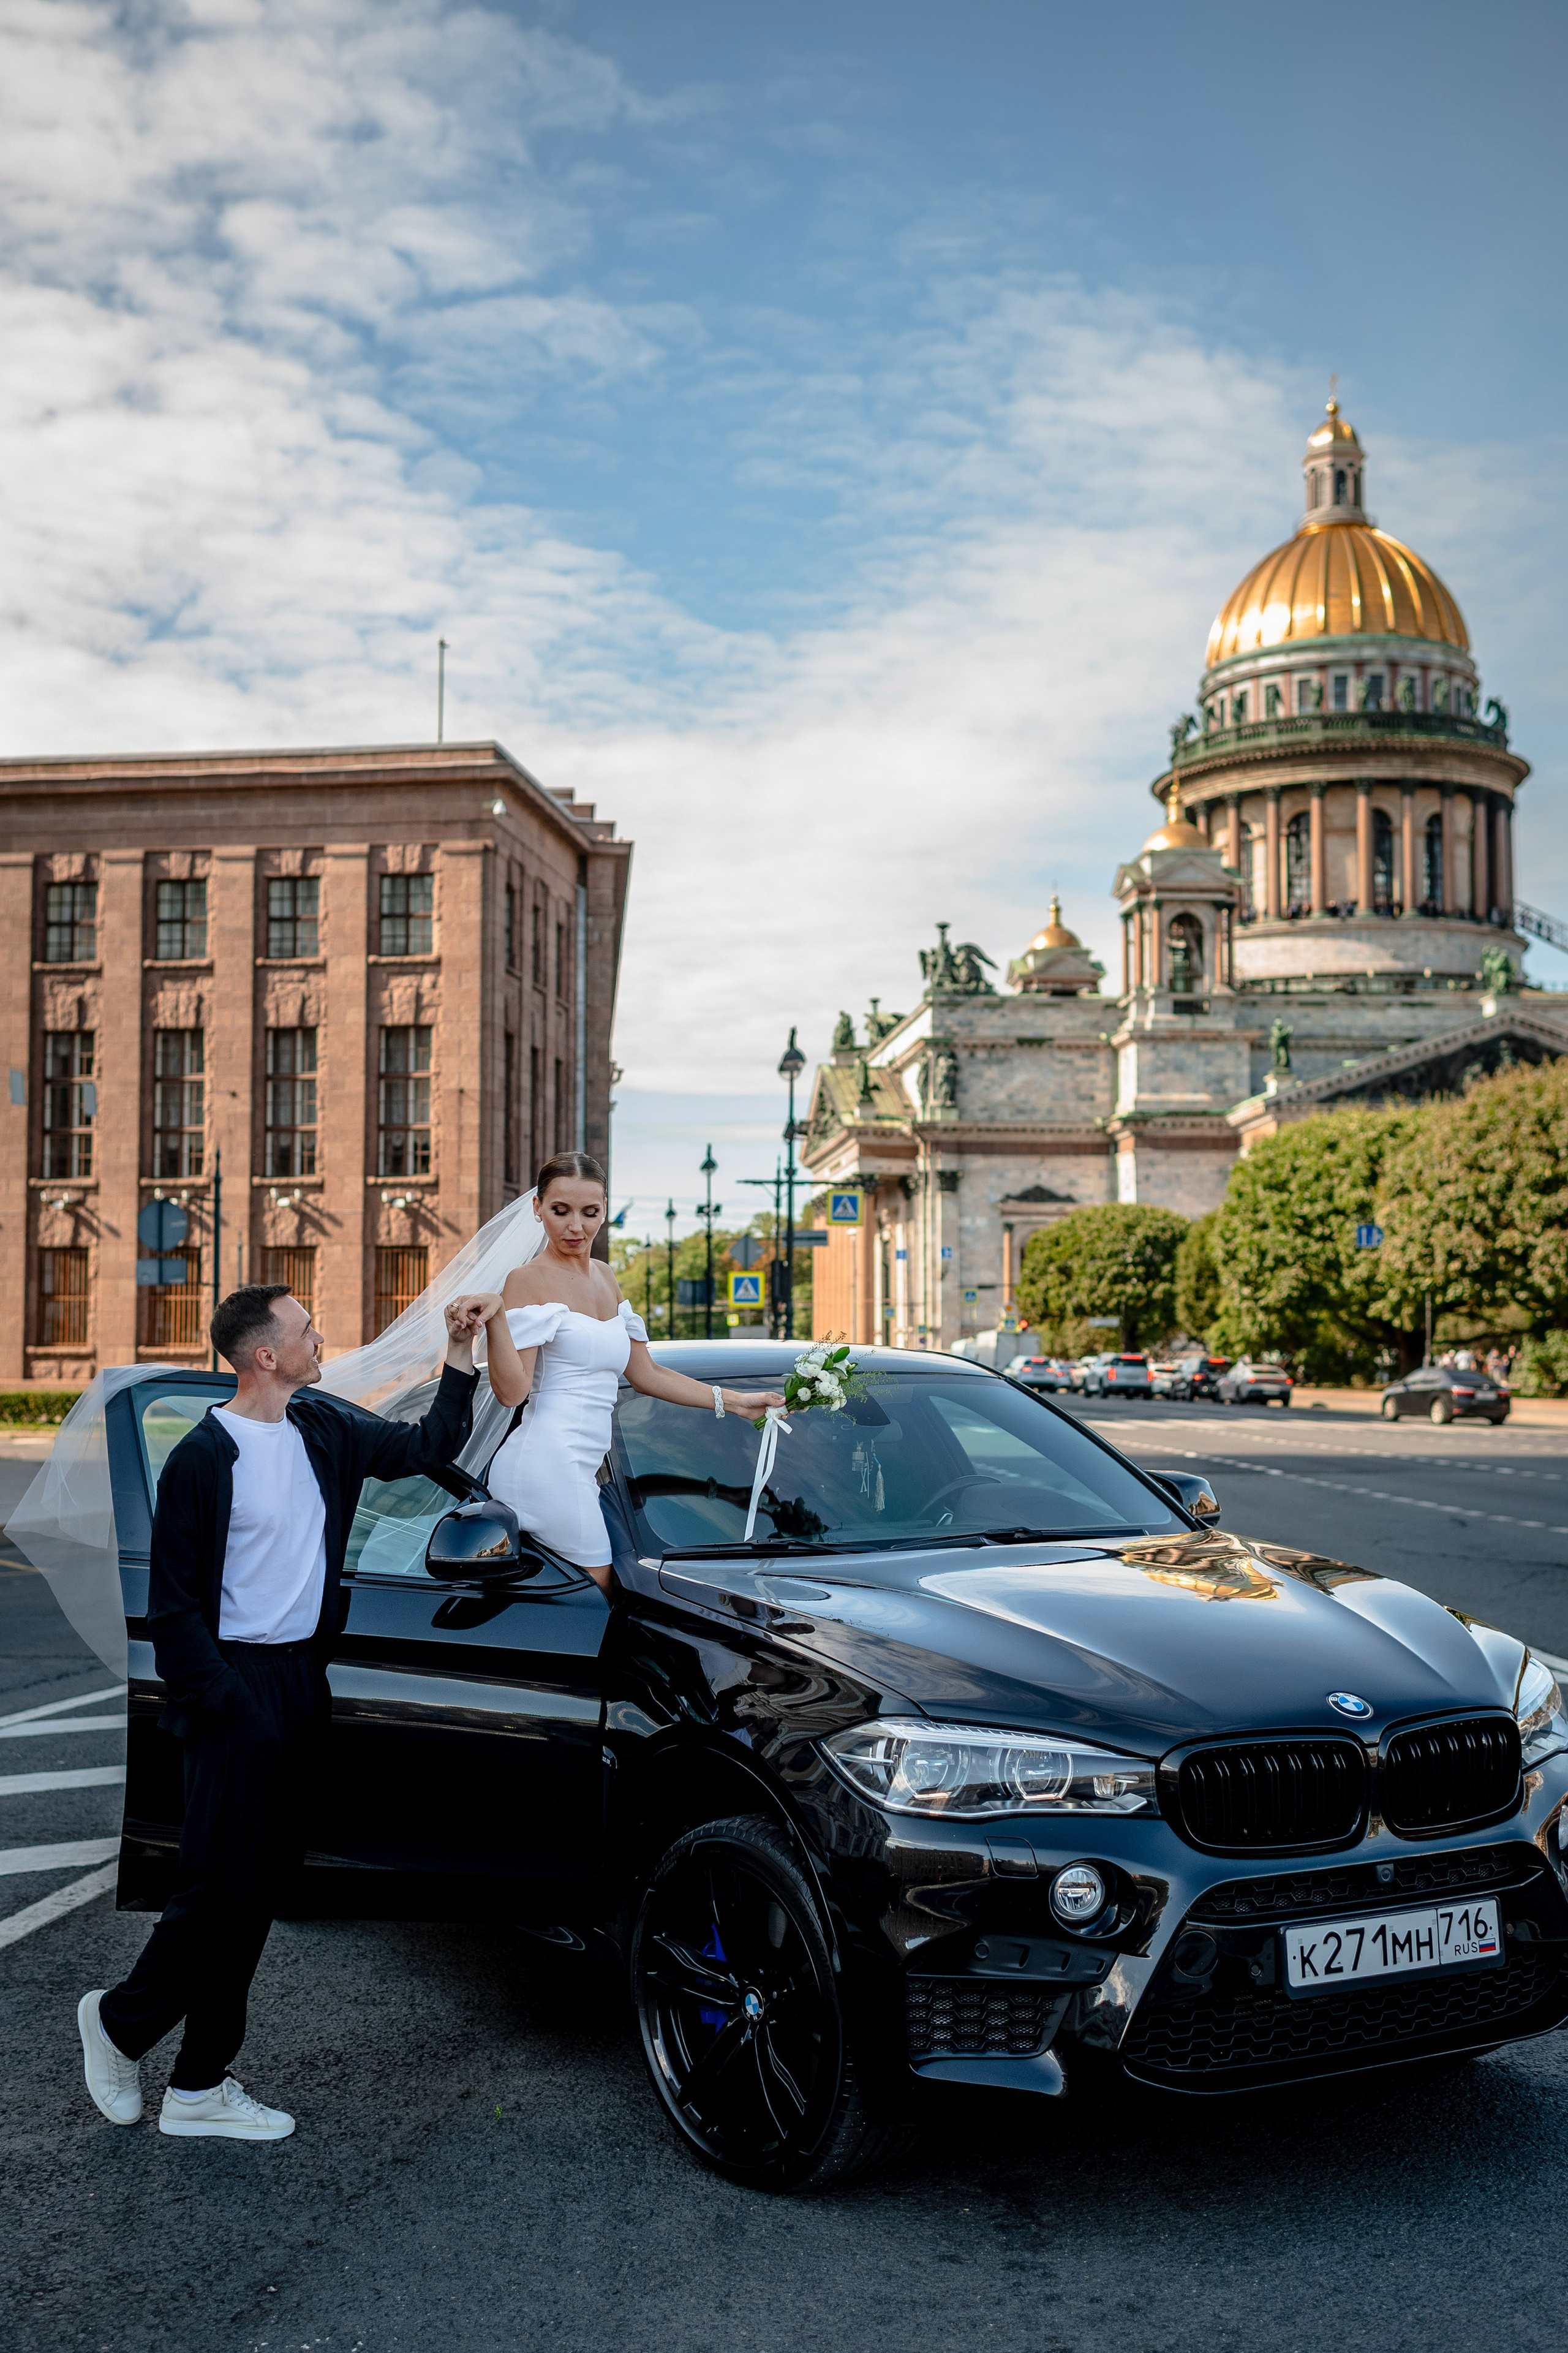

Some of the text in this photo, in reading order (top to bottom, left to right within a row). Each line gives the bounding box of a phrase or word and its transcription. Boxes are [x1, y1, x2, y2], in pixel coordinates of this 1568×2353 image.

[1440, 1907, 1488, 1944] 716
[1454, 1943, 1479, 1956] RUS
[746, 2008, 763, 2020] BMW
